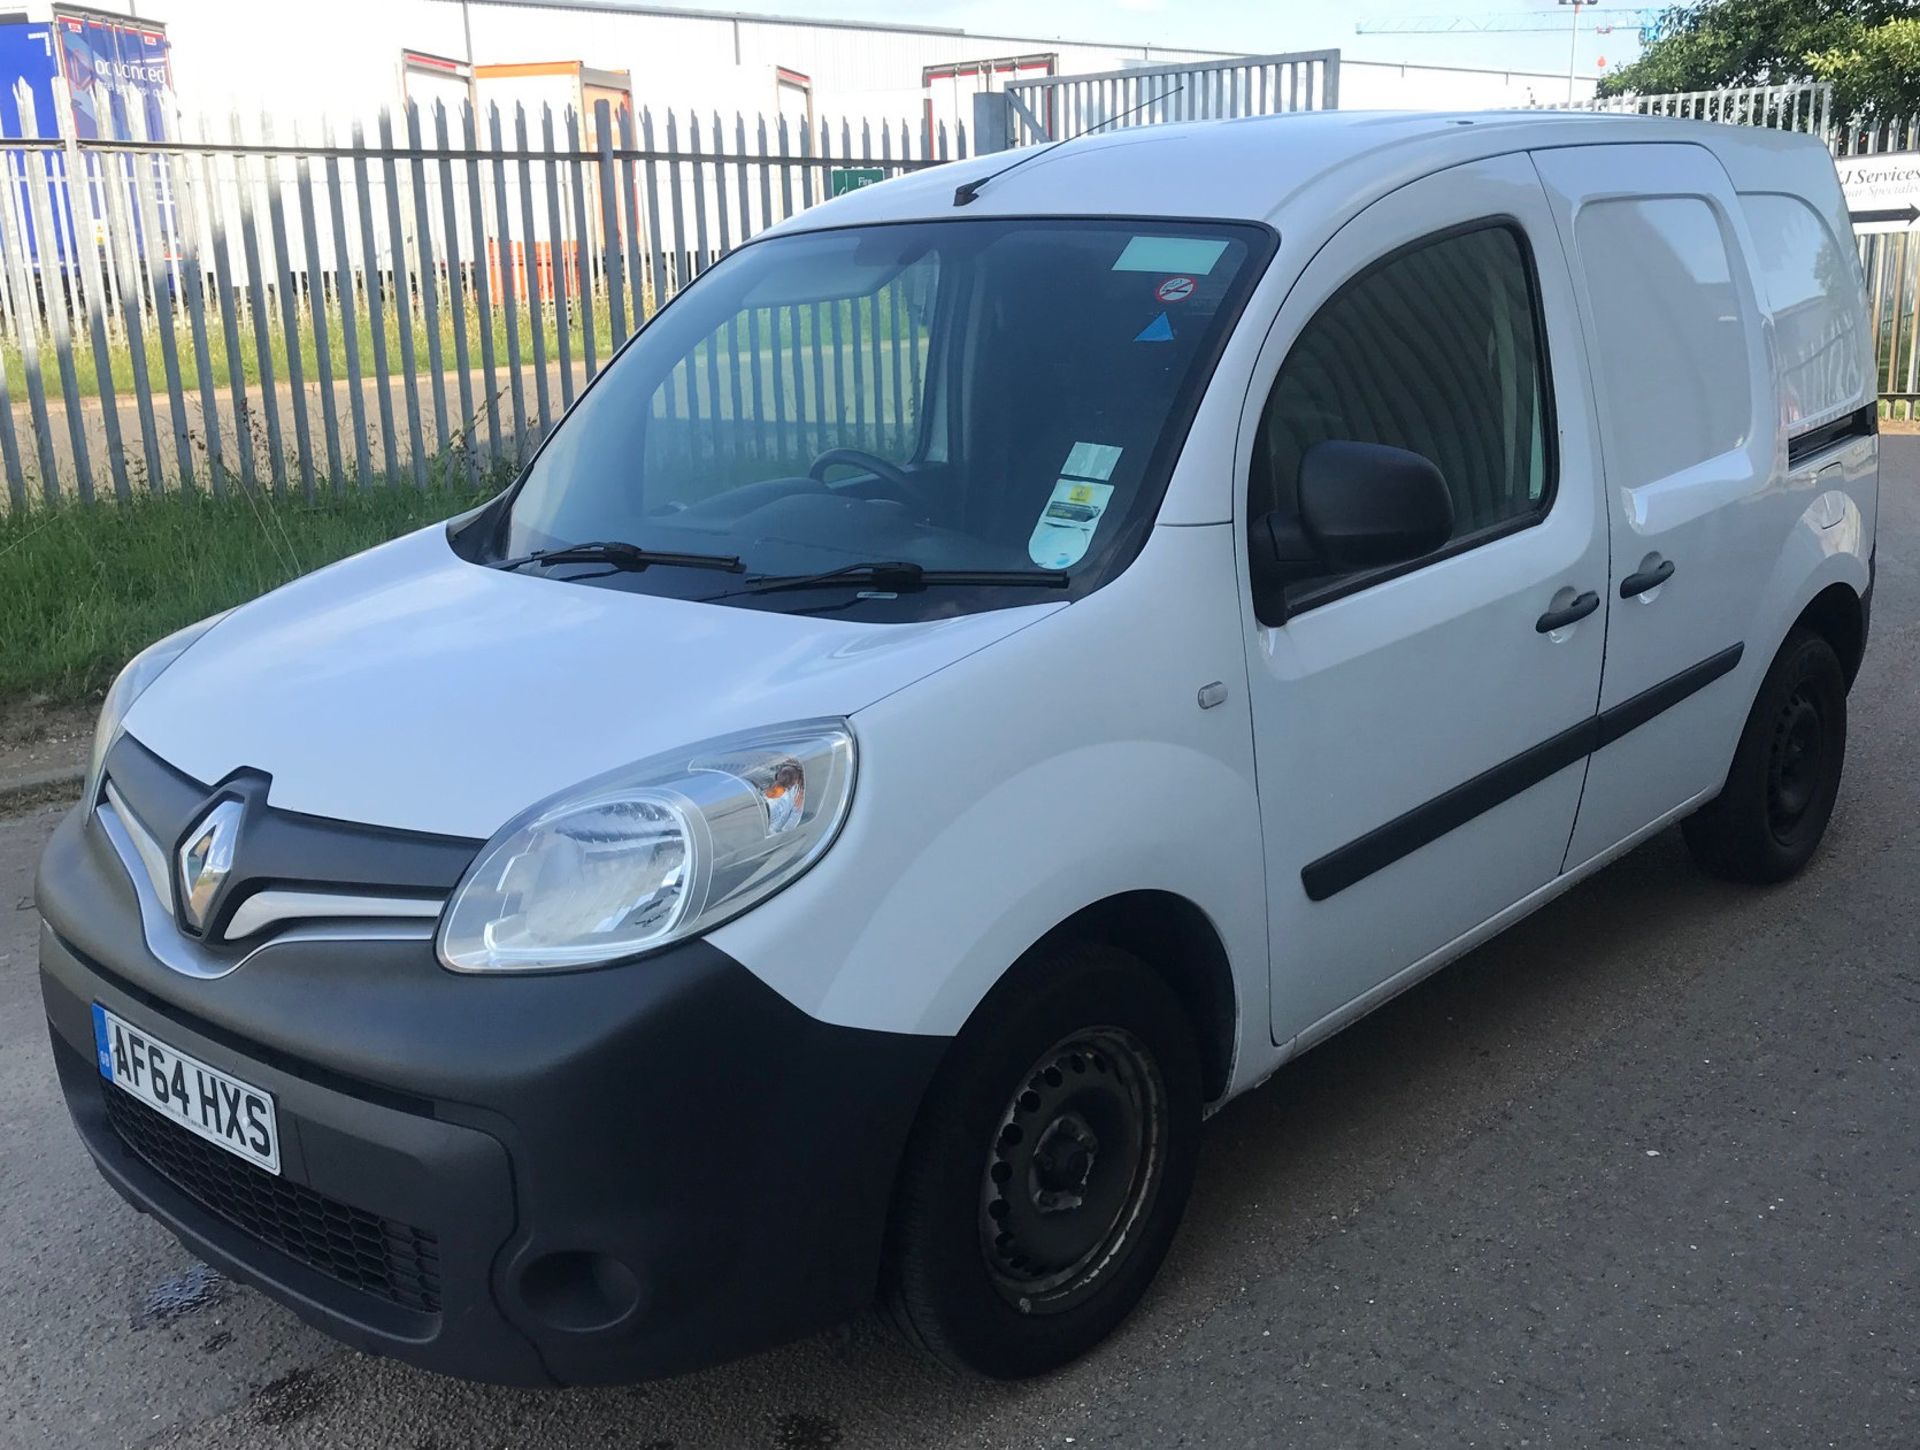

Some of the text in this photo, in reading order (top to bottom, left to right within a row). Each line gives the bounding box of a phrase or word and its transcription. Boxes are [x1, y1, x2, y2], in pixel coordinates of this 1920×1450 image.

[1854, 166, 1920, 185] Services
[114, 1025, 271, 1157] AF64 HXS
